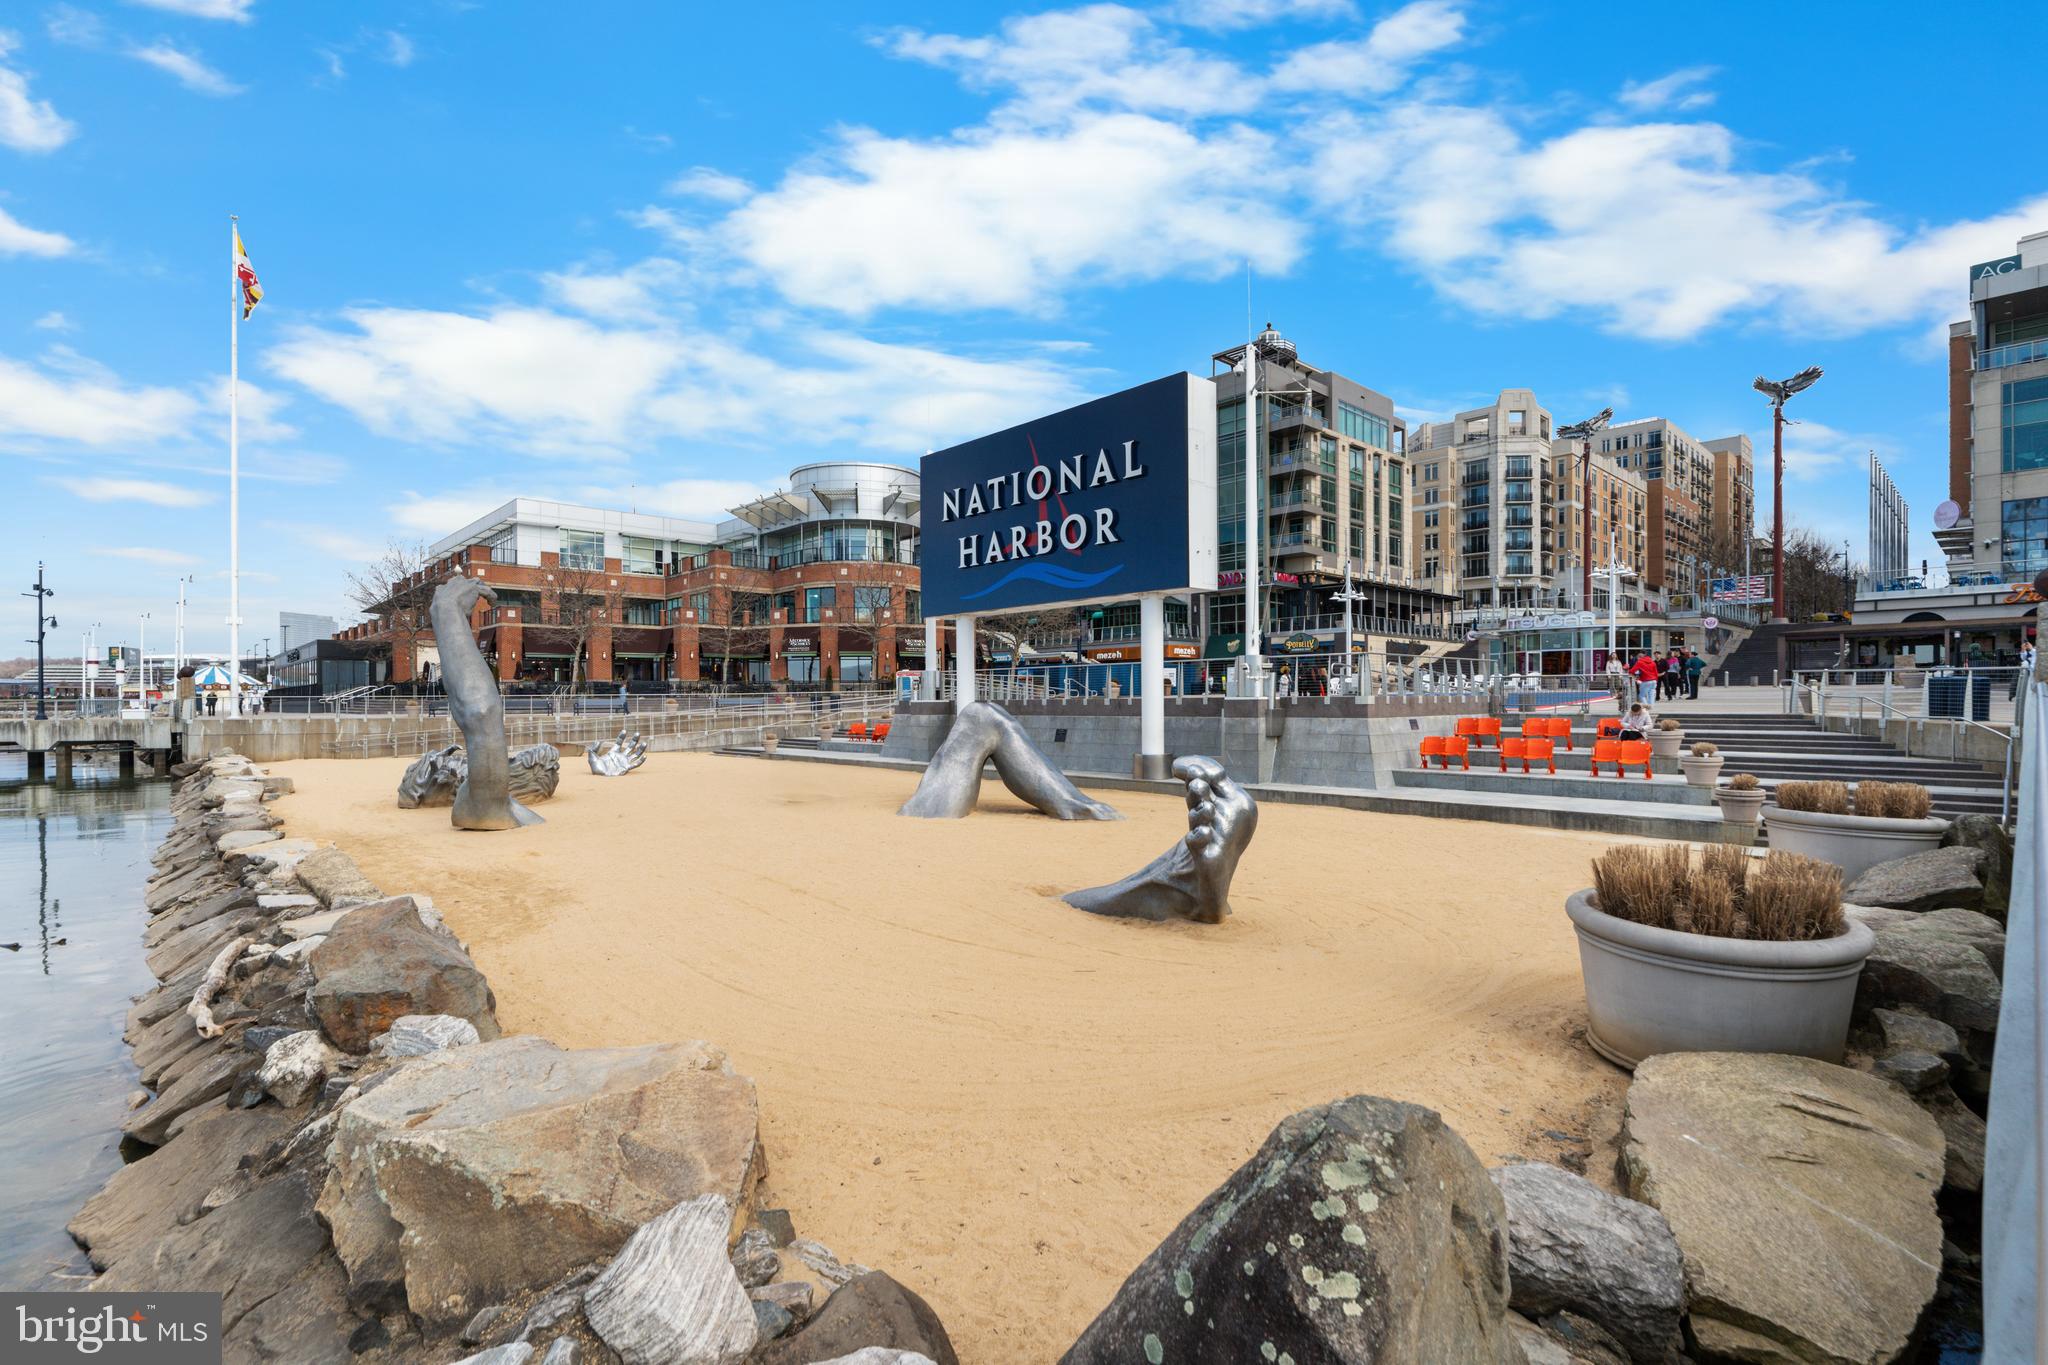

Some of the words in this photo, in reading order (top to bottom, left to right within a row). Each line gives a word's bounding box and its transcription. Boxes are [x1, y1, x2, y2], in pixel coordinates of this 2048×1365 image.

[1979, 260, 2016, 280] AC
[942, 440, 1143, 522] NATIONAL
[958, 508, 1119, 569] HARBOR
[1173, 647, 1196, 655] mezeh
[1286, 638, 1315, 649] POTBELLY
[1096, 650, 1122, 660] mezeh
